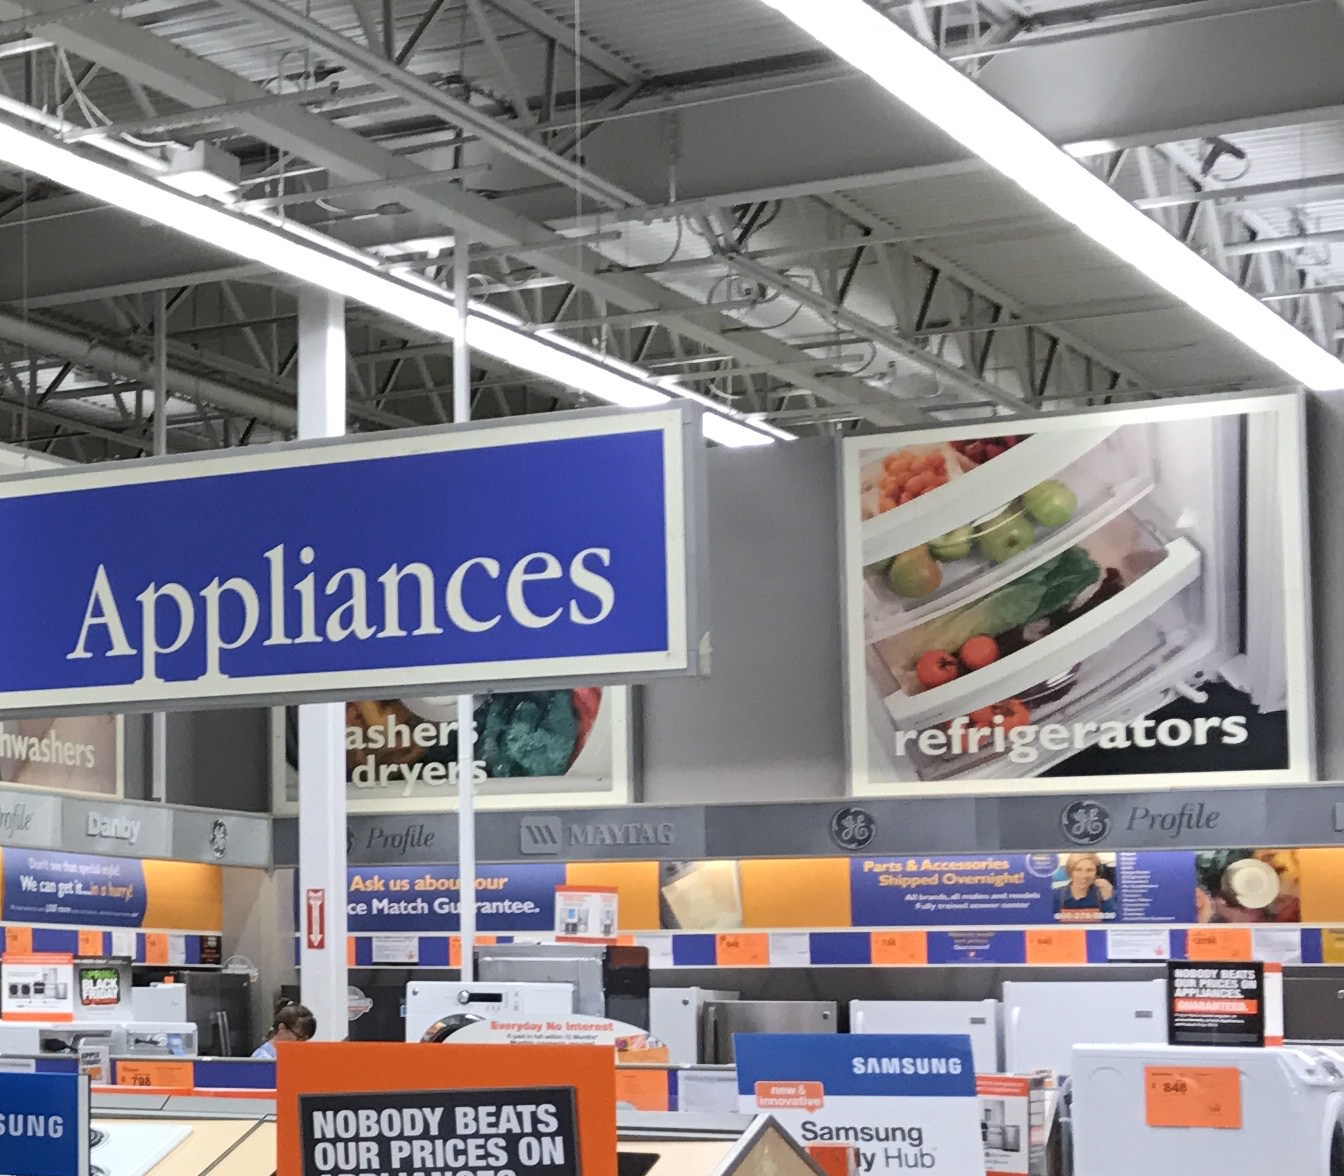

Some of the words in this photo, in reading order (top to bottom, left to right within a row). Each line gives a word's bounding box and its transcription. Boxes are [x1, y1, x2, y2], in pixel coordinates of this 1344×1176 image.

[66, 542, 615, 682] Appliances
[894, 713, 1250, 764] refrigerators
[87, 811, 141, 844] Danby
[567, 821, 676, 847] MAYTAG
[1126, 802, 1221, 840] Profile
[366, 824, 436, 856] Profile
[863, 860, 902, 873] Parts
[920, 858, 1009, 872] Accessories
[20, 875, 38, 892] We
[39, 881, 57, 893] can
[57, 880, 74, 898] get
[349, 874, 385, 891] Ask
[389, 878, 410, 891] us
[414, 874, 461, 891] abou
[474, 876, 509, 890] our
[878, 872, 939, 888] Shipped
[943, 871, 1025, 888] Overnight!
[372, 897, 429, 915] Match
[433, 897, 541, 914] Gurantee.
[490, 1020, 542, 1033] Everyday
[546, 1021, 563, 1031] No
[566, 1021, 614, 1032] Interest
[852, 1057, 962, 1076] SAMSUNG
[312, 1106, 445, 1139] NOBODY
[455, 1104, 559, 1135] BEATS
[800, 1120, 924, 1147] Samsung
[314, 1140, 380, 1171] OUR
[390, 1137, 509, 1169] PRICES
[518, 1136, 565, 1166] ON
